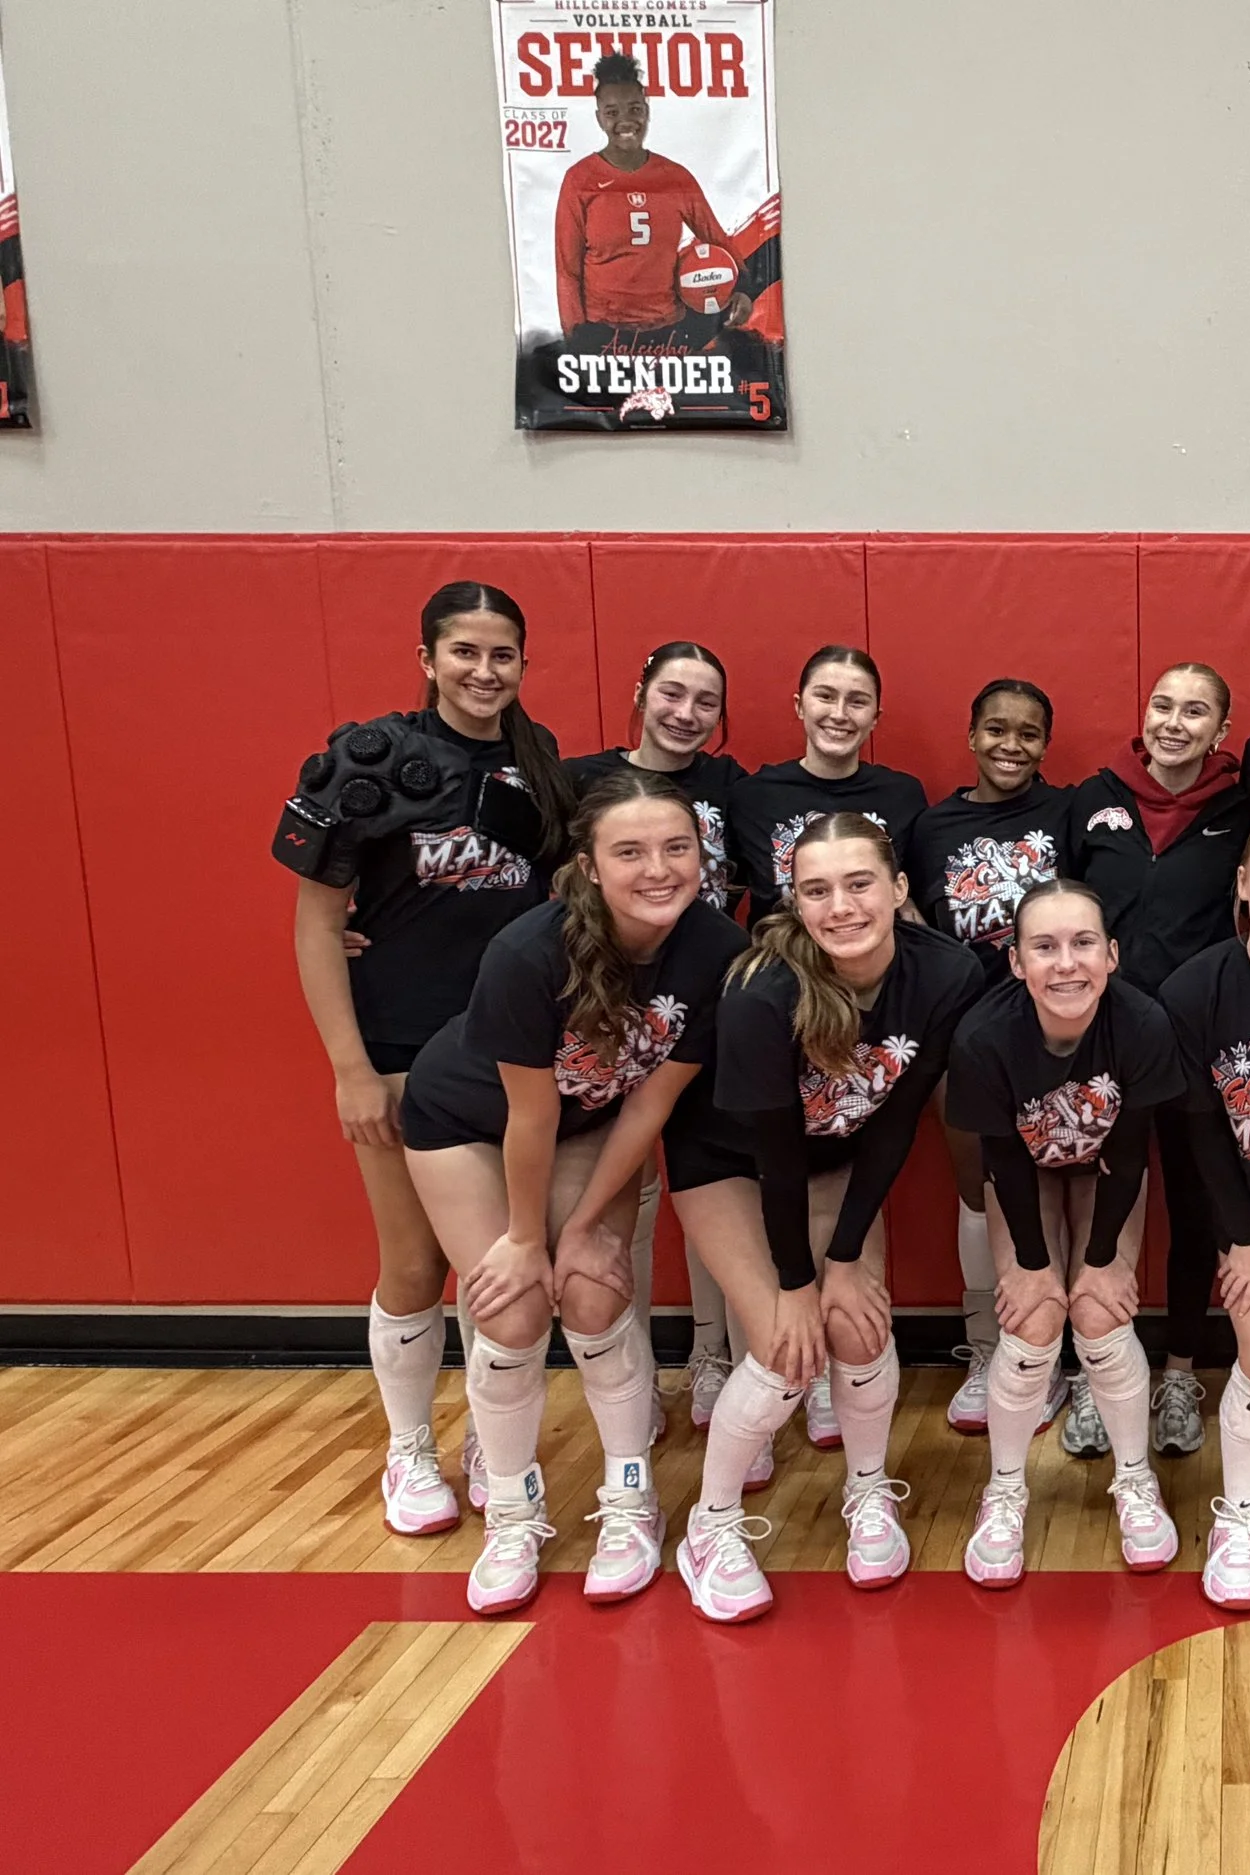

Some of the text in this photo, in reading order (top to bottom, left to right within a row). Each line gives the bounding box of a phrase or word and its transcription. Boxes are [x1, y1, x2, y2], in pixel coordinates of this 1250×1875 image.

[555, 0, 707, 10] HILLCREST COMETS
[573, 14, 692, 27] VOLLEYBALL
[504, 109, 568, 120] CLASS OF
[505, 120, 568, 148] 2027
[629, 211, 651, 246] 5
[557, 354, 772, 422] STENDER #5
